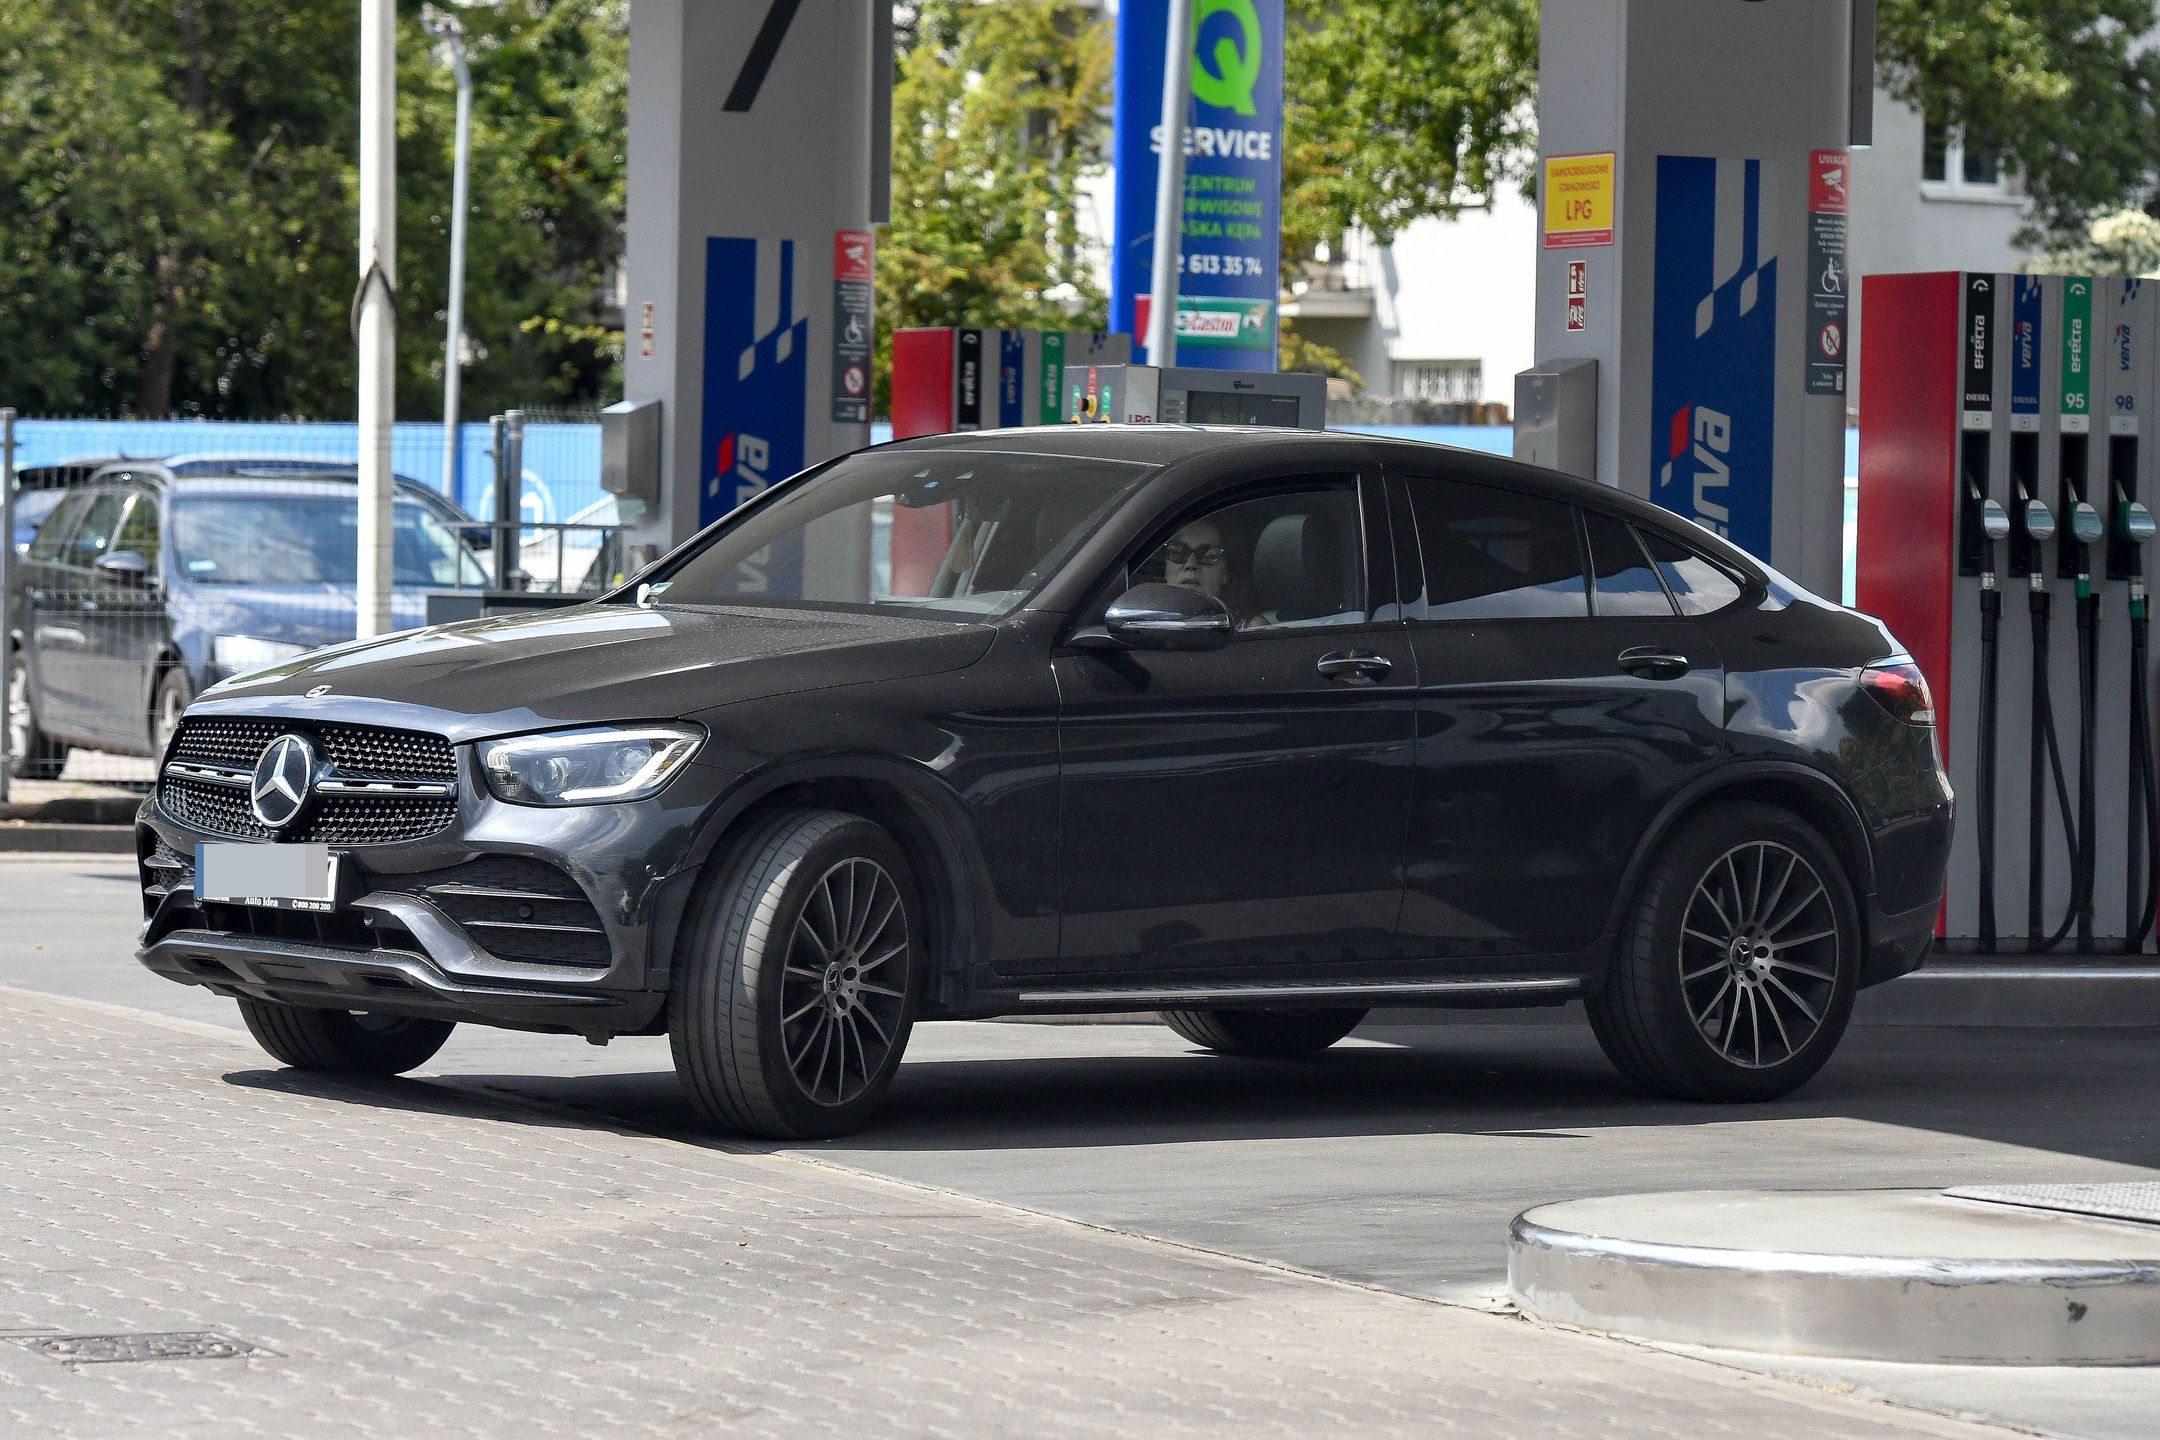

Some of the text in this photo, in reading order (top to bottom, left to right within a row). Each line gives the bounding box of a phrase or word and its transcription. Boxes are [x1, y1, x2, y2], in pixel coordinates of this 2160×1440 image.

[1566, 199, 1593, 221] LPG
[2120, 324, 2131, 371] verva
[1966, 393, 1990, 402] DIESEL
[2065, 393, 2085, 409] 95
[2116, 395, 2134, 410] 98
[244, 896, 279, 908] Auto Idea
